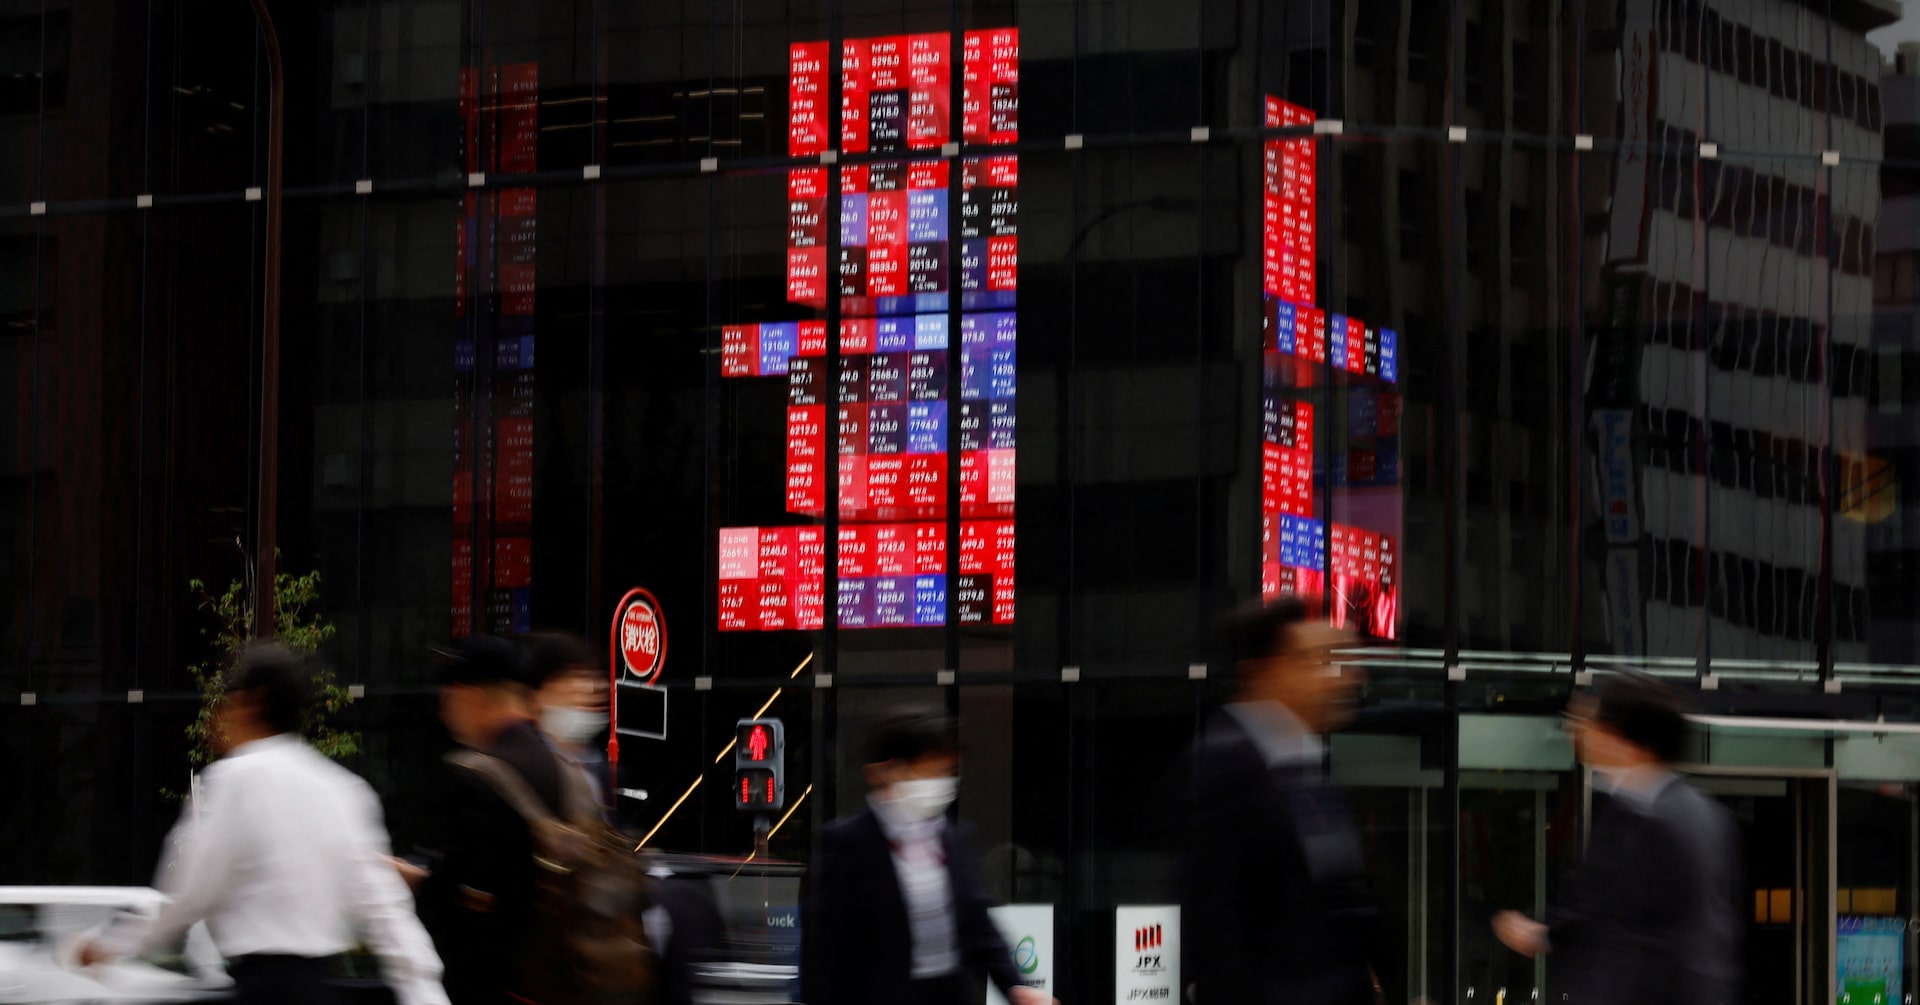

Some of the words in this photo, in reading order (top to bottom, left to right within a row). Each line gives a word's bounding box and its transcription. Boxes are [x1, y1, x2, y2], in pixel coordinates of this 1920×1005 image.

[870, 106, 900, 120] 2418.0
[910, 207, 938, 219] 3221.0
[791, 213, 819, 226] 1144.0
[910, 260, 938, 272] 2013.0
[790, 424, 818, 436] 6212.0
[722, 596, 744, 608] 176.7
[916, 591, 944, 602] 1921.0
[625, 622, 655, 654] 消火栓
[1135, 956, 1161, 968] JPX
